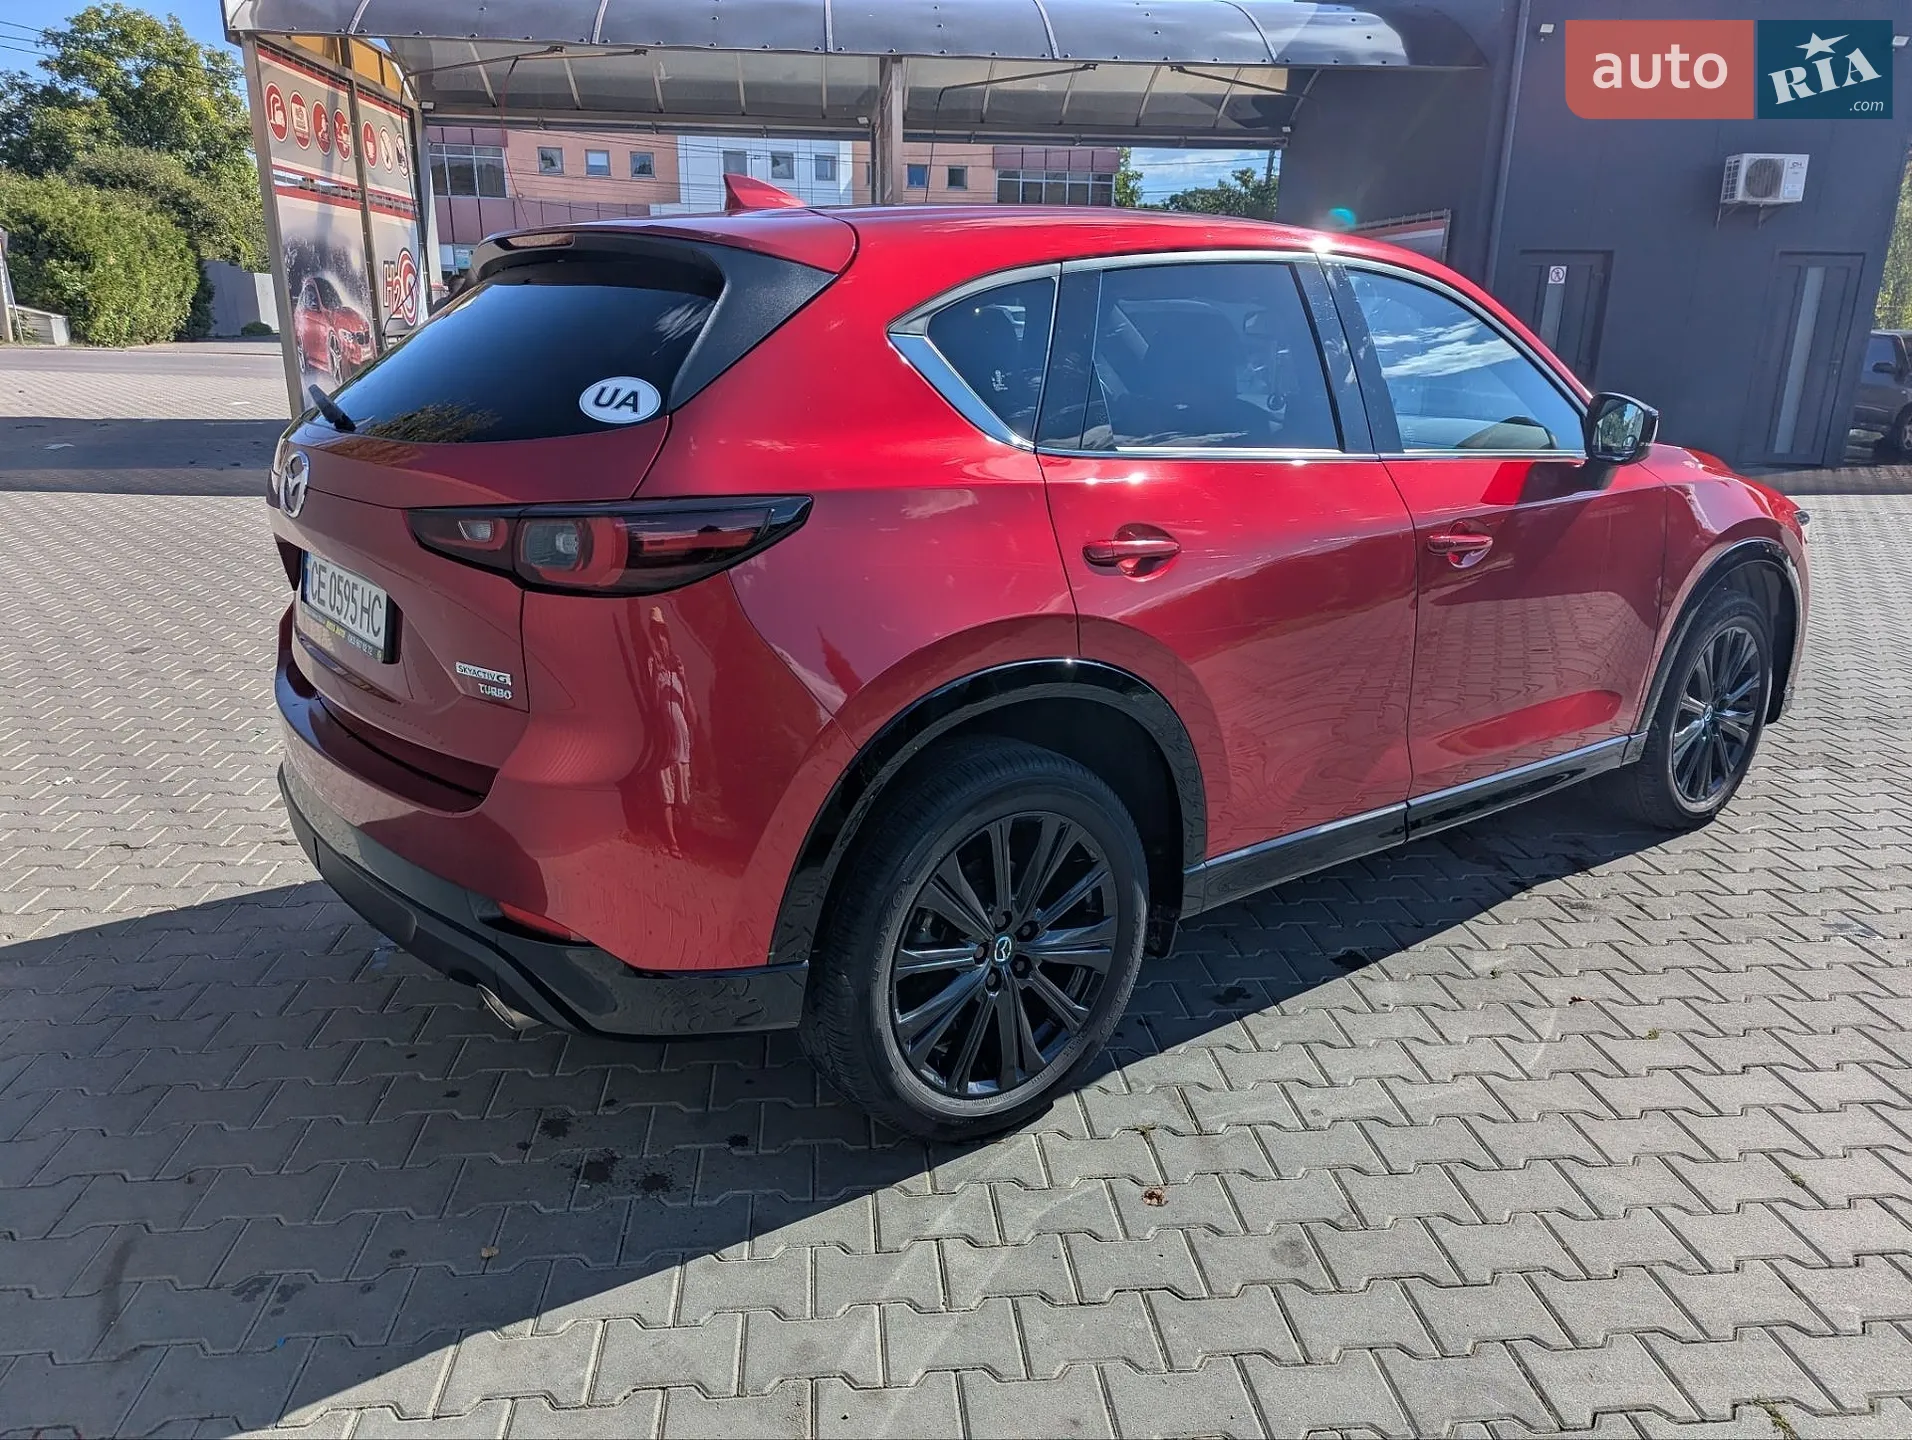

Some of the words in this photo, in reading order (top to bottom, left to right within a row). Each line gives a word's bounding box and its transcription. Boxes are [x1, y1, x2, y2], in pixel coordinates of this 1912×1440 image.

[593, 385, 640, 414] UA
[310, 560, 327, 608] CE
[328, 571, 359, 626] 0595
[359, 586, 383, 638] HC
[477, 682, 513, 700] TURBO
